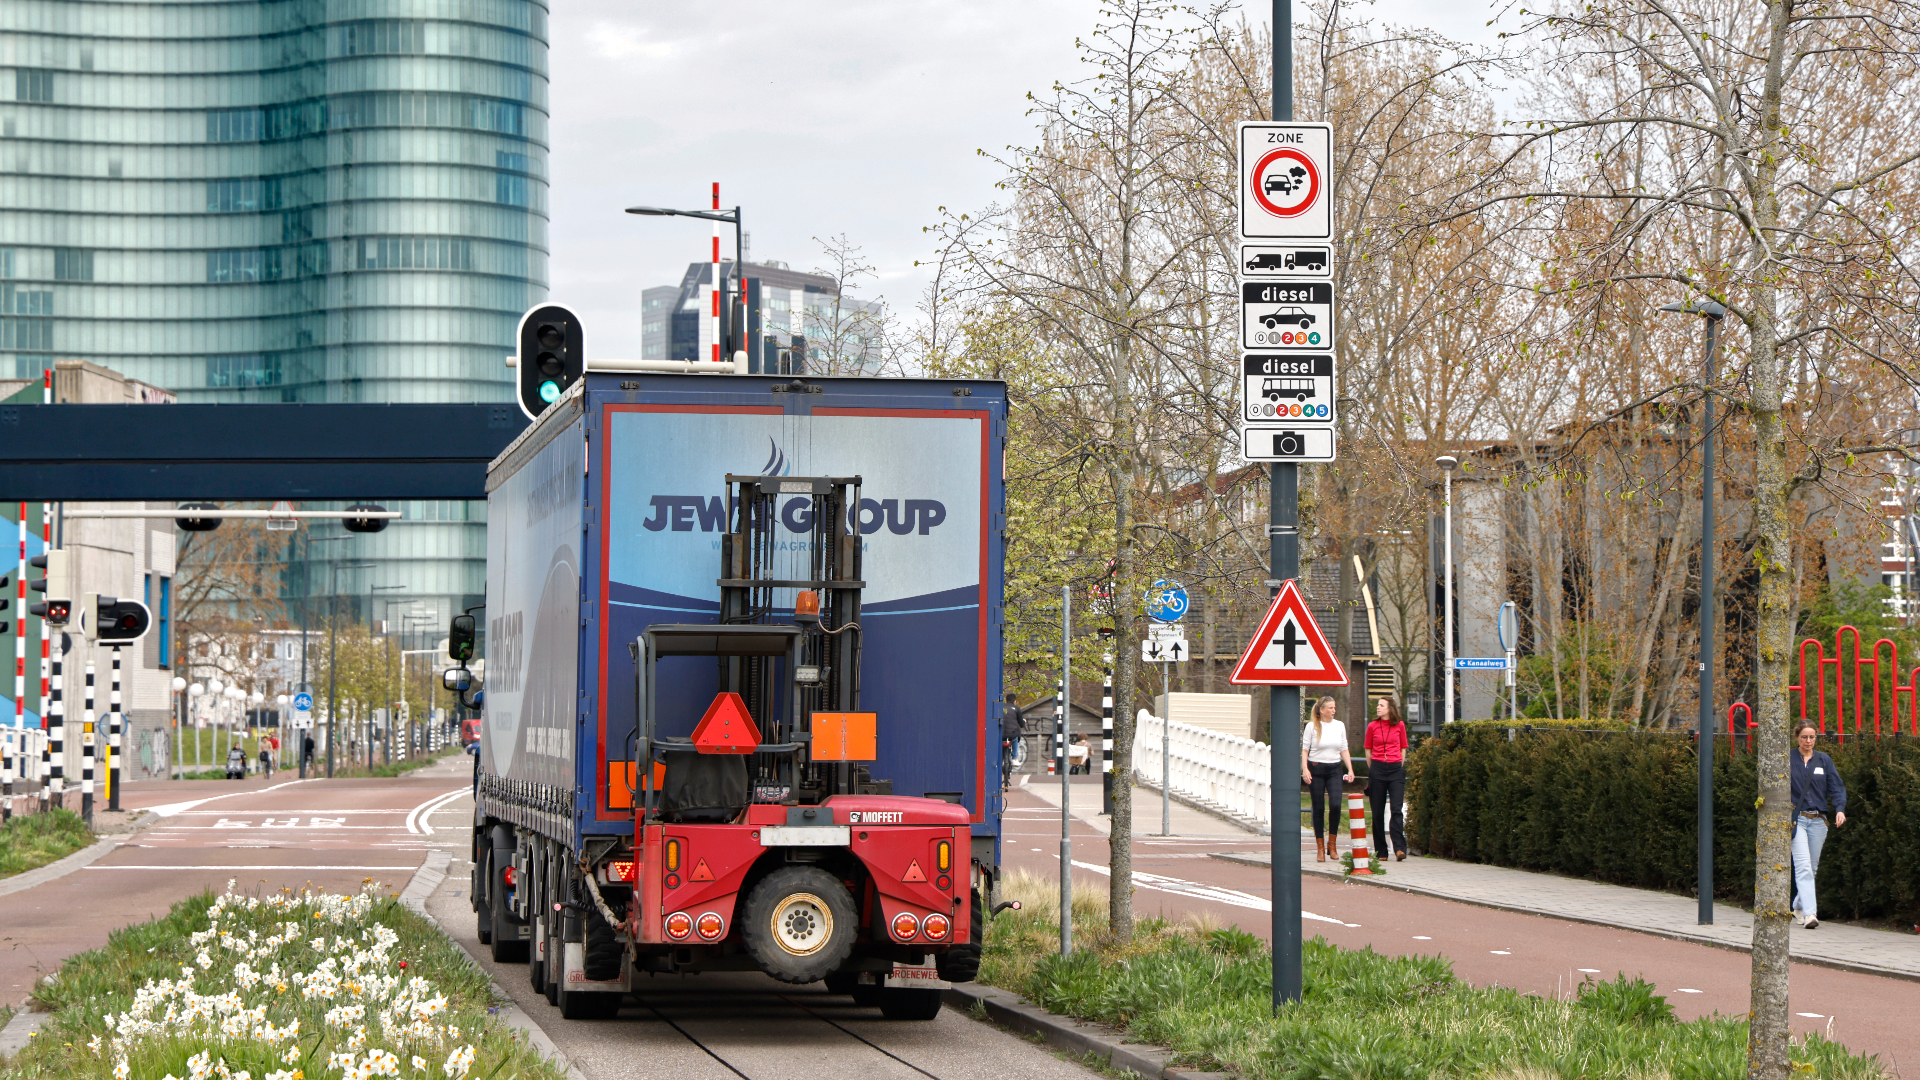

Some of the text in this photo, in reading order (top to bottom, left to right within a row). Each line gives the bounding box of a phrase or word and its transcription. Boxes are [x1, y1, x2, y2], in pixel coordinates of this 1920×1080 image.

[1267, 132, 1304, 143] ZONE
[1261, 286, 1314, 302] diesel
[1262, 359, 1315, 374] diesel
[781, 496, 946, 535] GOUP
[1467, 660, 1504, 668] Kanaalweg
[862, 811, 904, 823] MOFFETT
